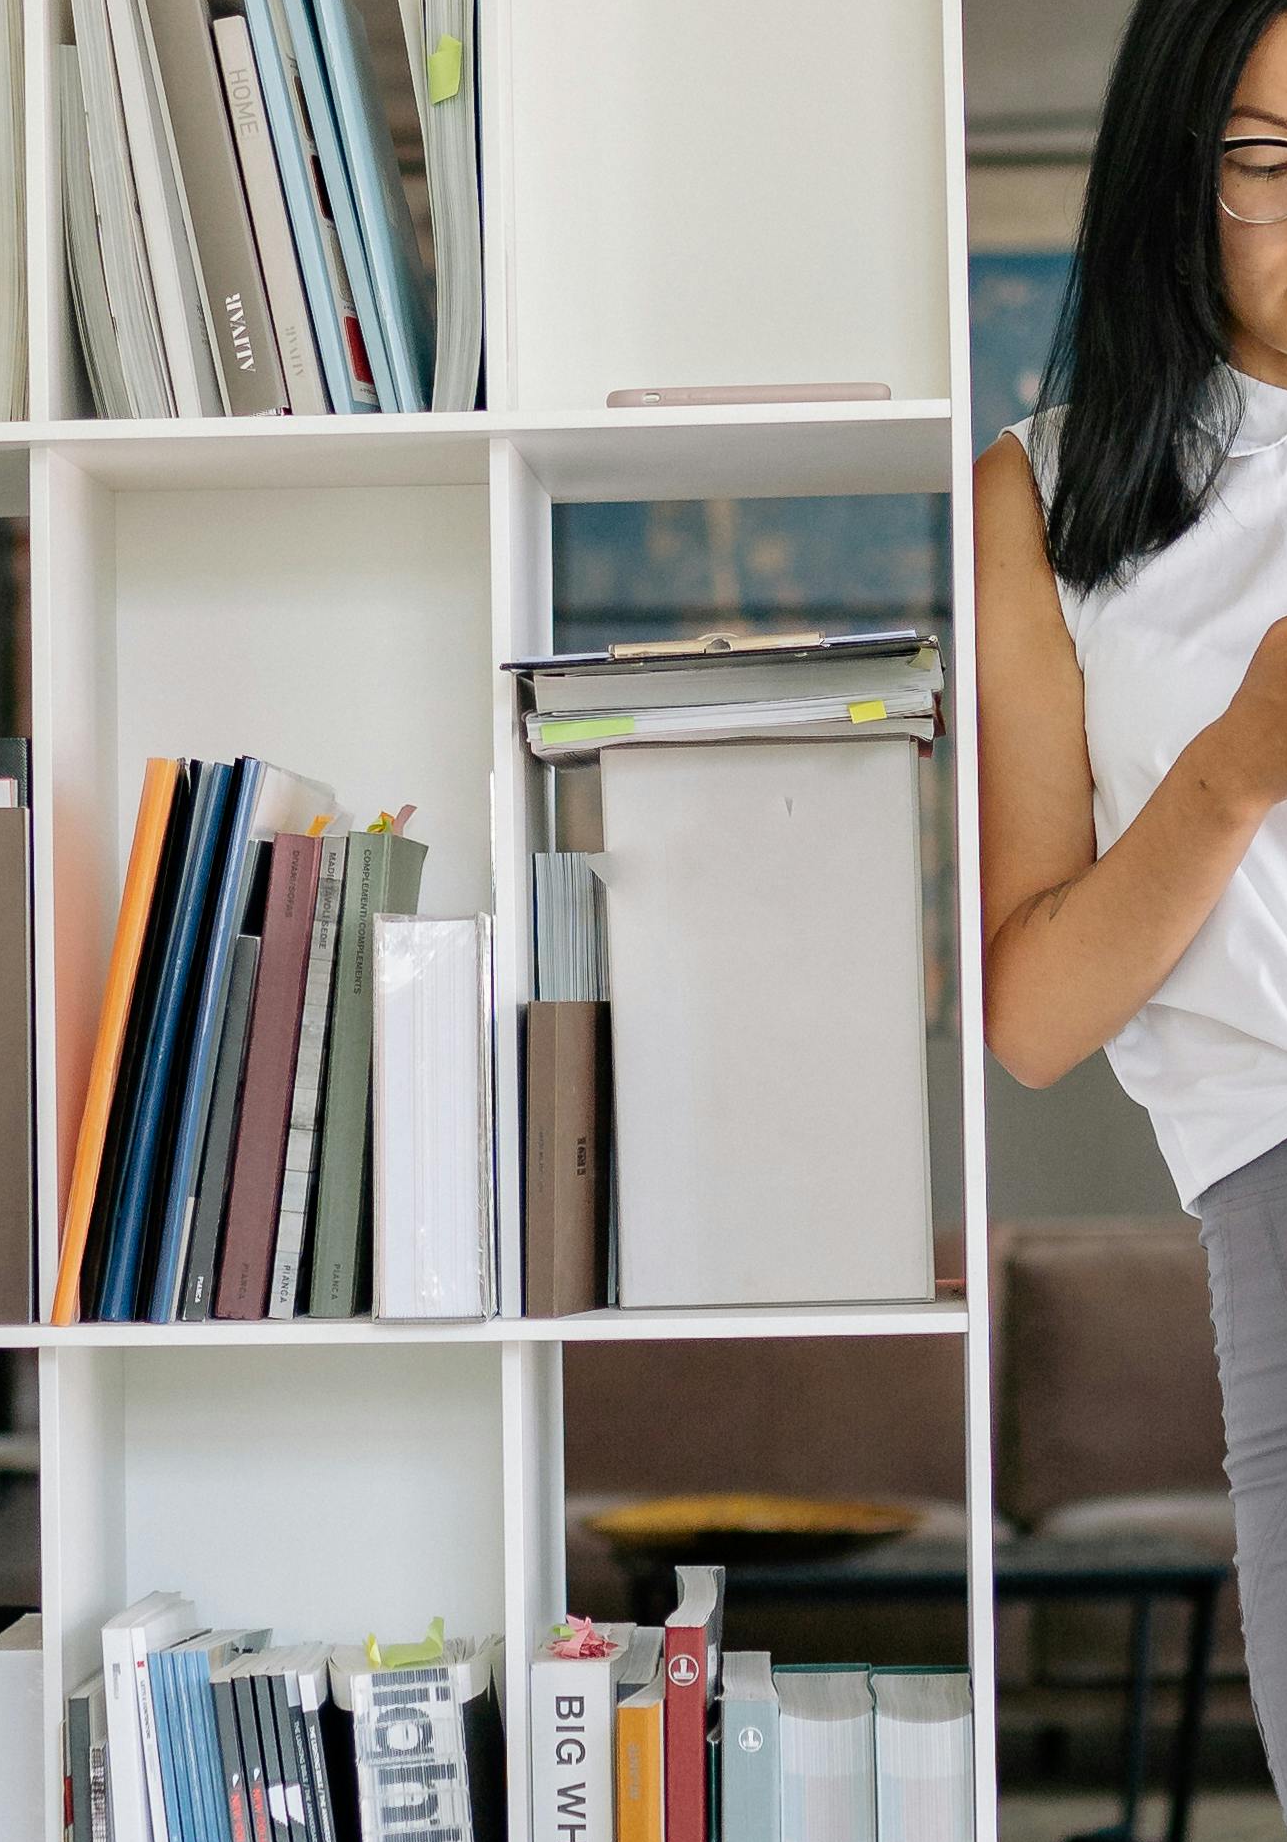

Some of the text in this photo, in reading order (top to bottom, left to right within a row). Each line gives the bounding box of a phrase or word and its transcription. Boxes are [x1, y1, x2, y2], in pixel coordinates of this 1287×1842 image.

[228, 68, 260, 138] HOME
[225, 291, 257, 373] ALIVAR
[318, 920, 329, 950] SEDIE
[353, 849, 372, 996] COMPLEMENTI/COMPLEMENTS
[279, 1265, 291, 1304] PIANCA
[330, 1263, 342, 1301] PIANCA
[555, 1694, 587, 1767] BIG
